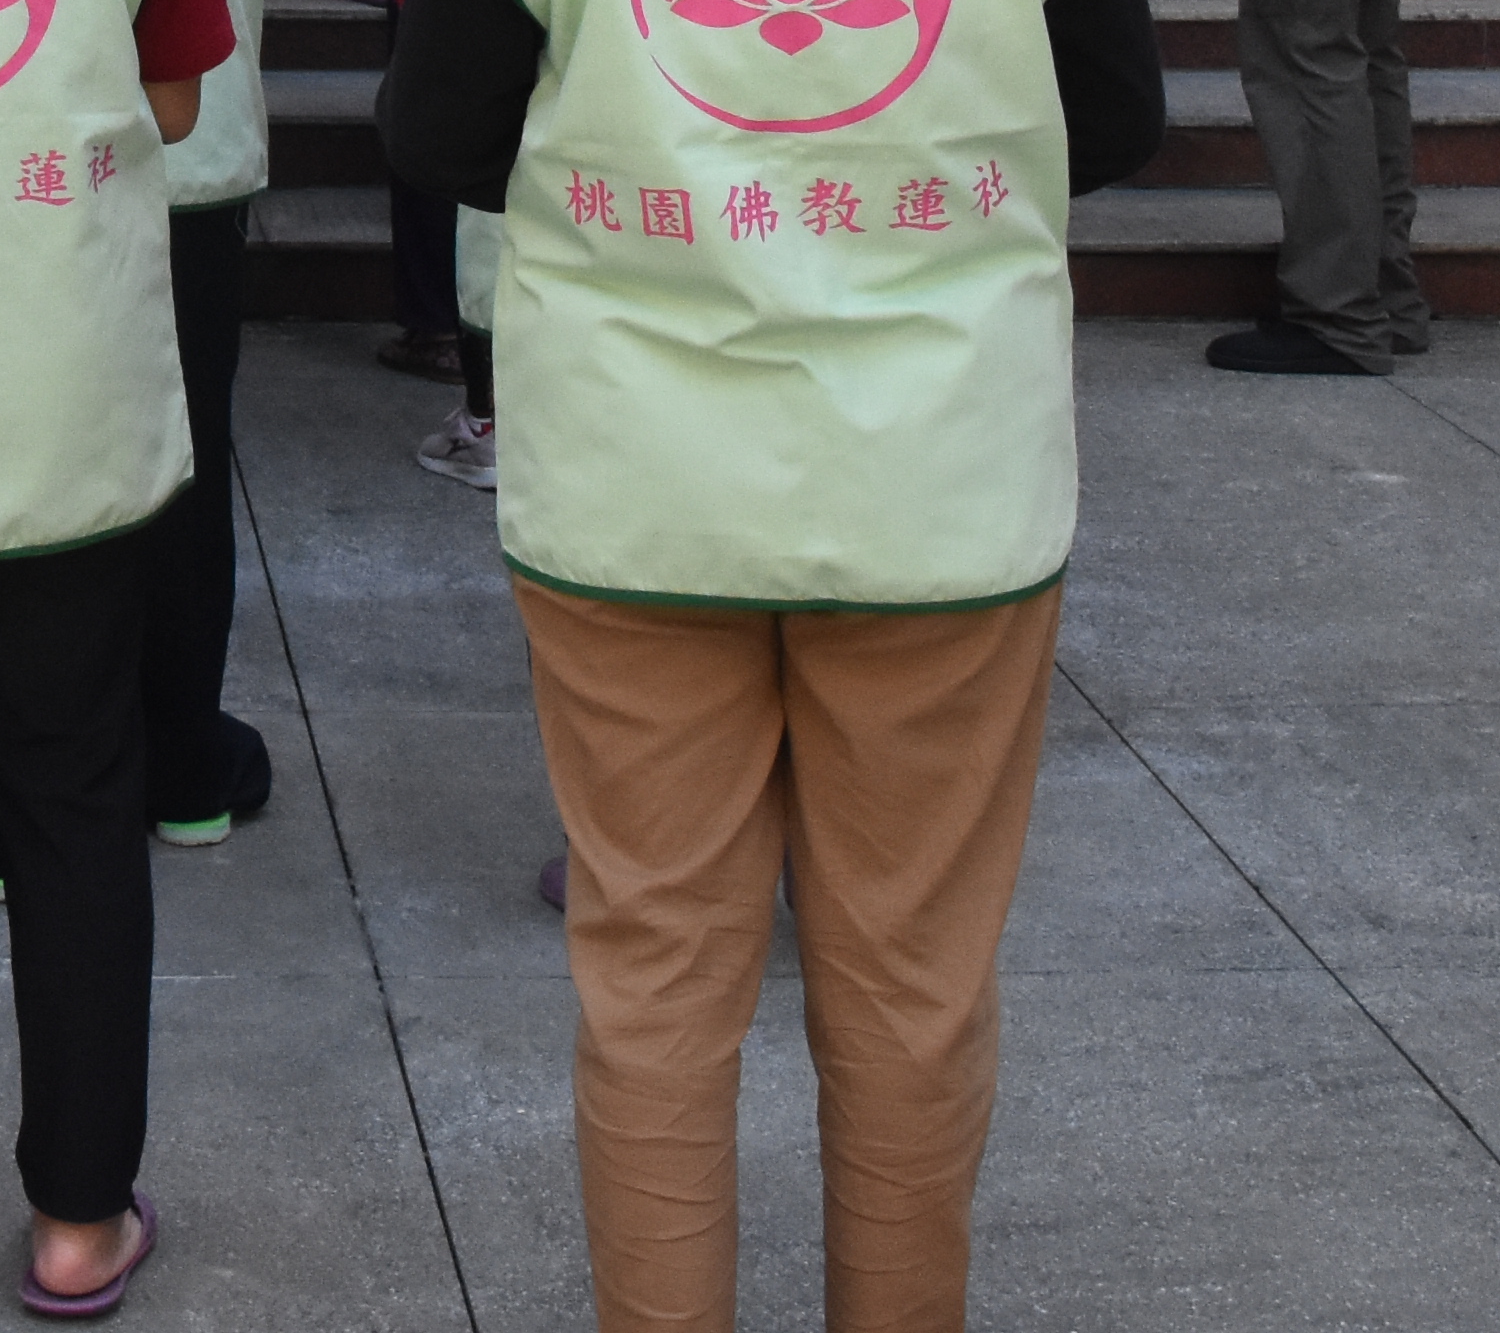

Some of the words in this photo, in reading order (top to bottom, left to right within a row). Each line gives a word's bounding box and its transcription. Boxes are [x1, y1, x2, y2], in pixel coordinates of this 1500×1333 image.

[564, 158, 1014, 247] 桃園佛教蓮社
